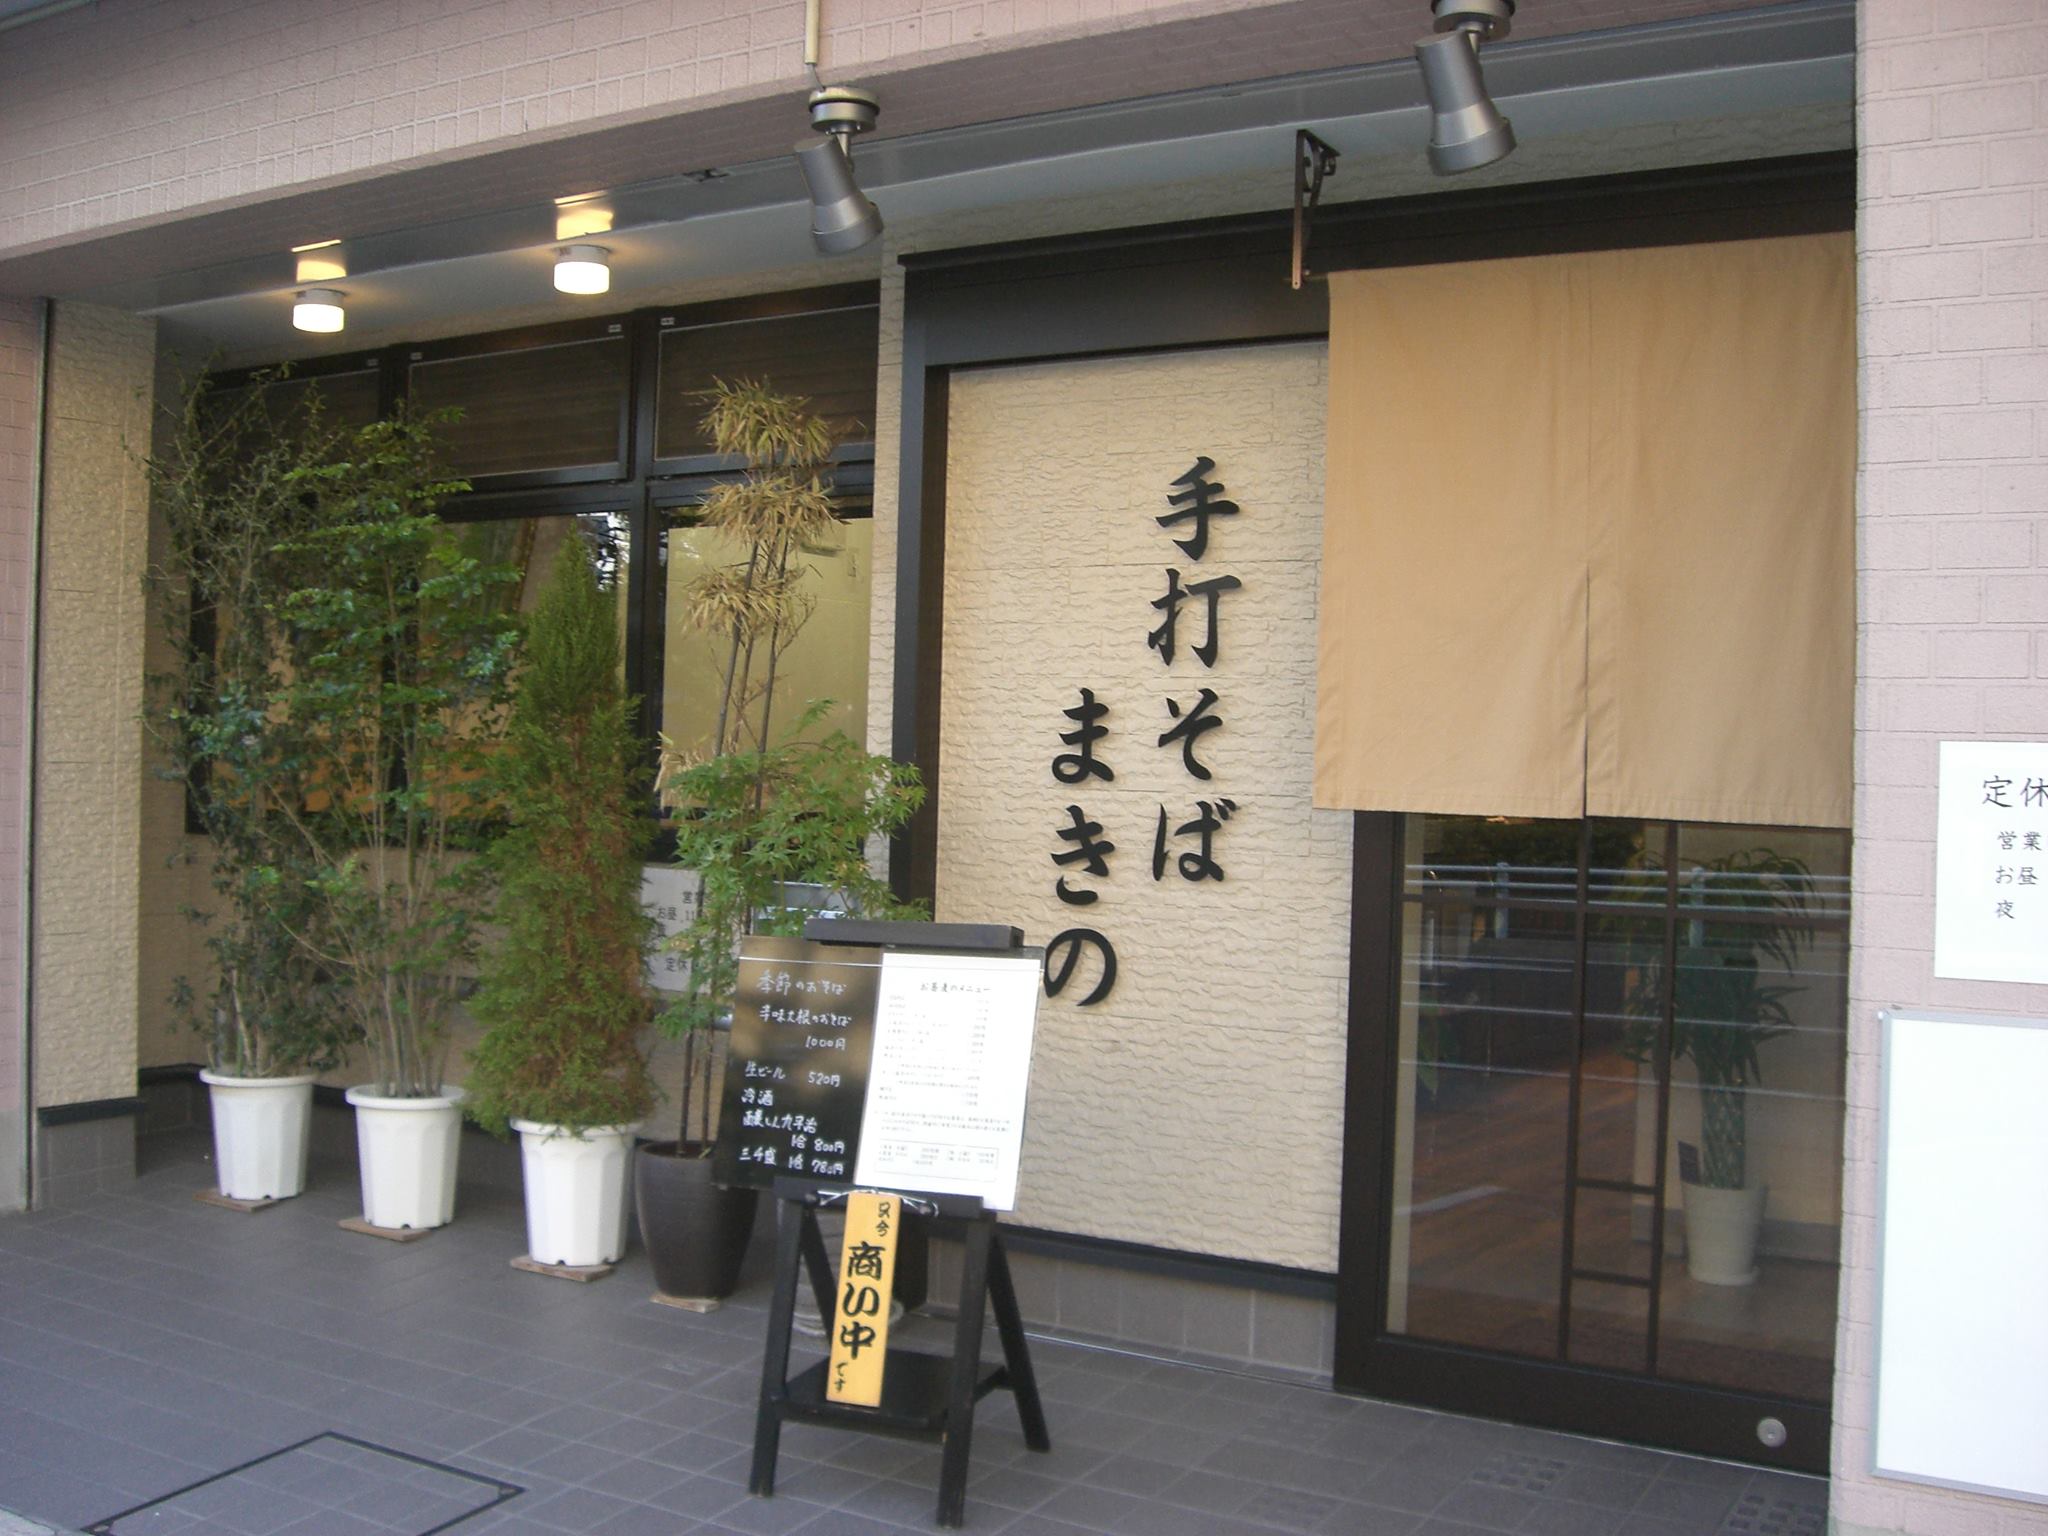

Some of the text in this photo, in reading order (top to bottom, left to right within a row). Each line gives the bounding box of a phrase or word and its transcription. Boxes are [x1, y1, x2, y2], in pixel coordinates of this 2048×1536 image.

[1148, 456, 1243, 883] 手打そば
[1981, 774, 2048, 808] 定休
[1044, 687, 1117, 1007] まきの
[1995, 864, 2039, 886] お昼
[1995, 899, 2016, 920] 夜
[756, 968, 847, 996] 季節のおそば
[759, 1004, 852, 1028] 辛味大根のおそば
[804, 1035, 846, 1051] 1000円
[744, 1060, 841, 1088] 生ビール 520円
[740, 1087, 774, 1106] 冷酒
[813, 1138, 845, 1155] 800円
[811, 1159, 844, 1176] 780円
[840, 1240, 887, 1361] 商い中
